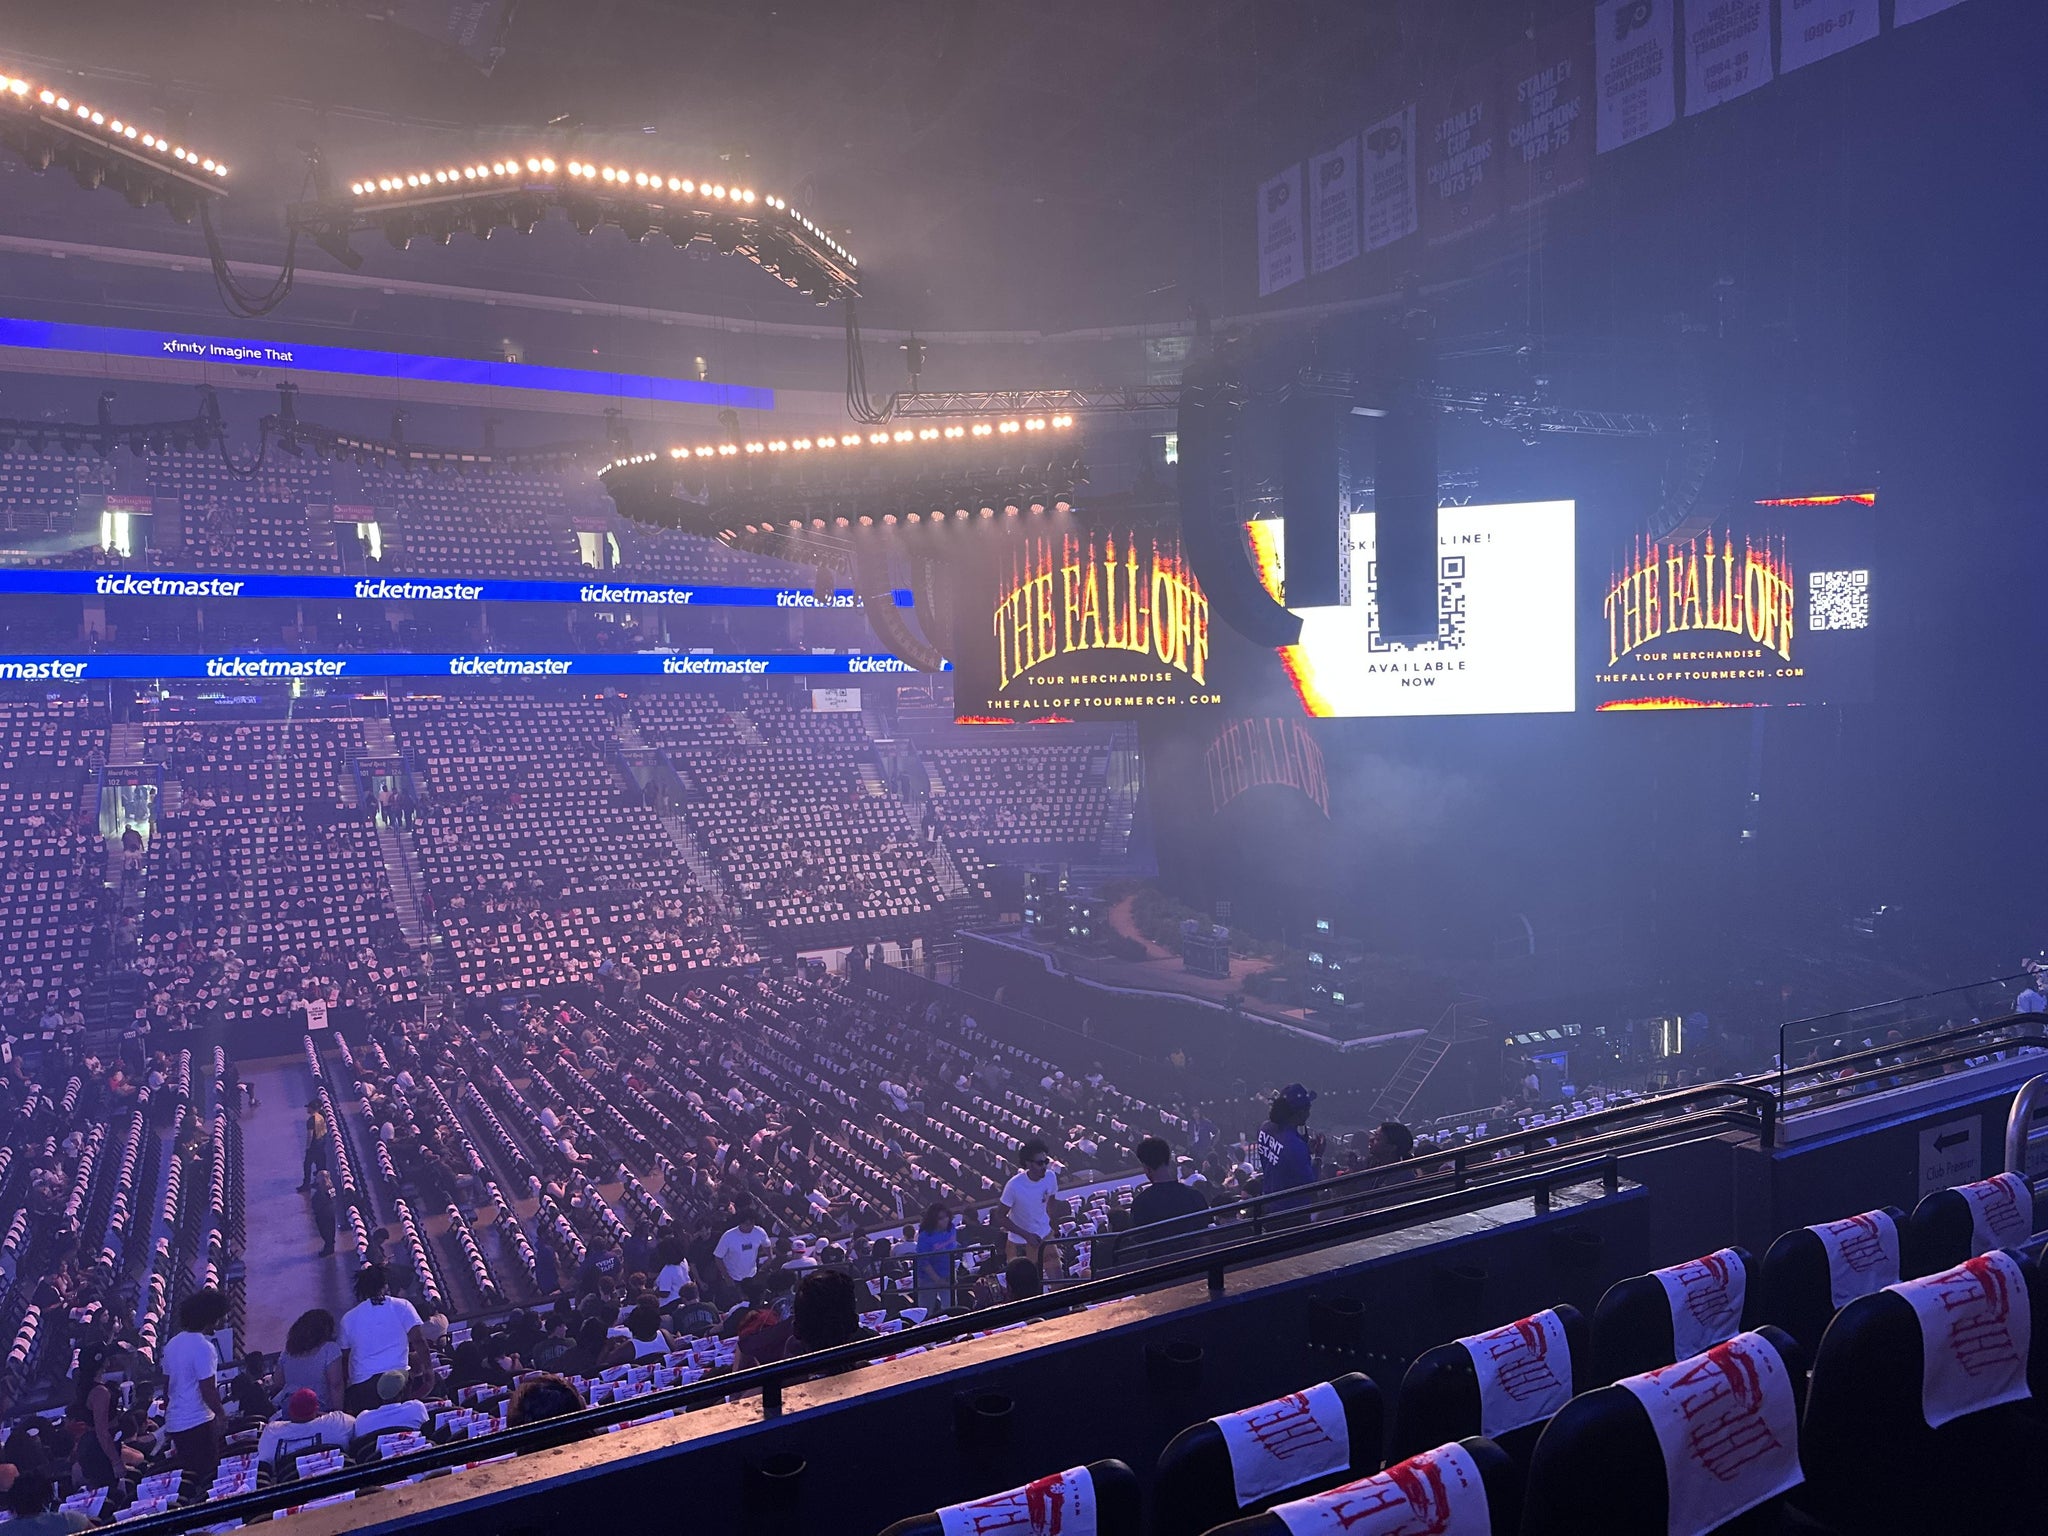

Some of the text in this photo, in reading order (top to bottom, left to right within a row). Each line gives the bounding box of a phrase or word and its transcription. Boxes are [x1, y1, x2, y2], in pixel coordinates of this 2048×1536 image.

[1804, 9, 1855, 43] 1996-97
[1517, 59, 1572, 102] STANLEY
[1531, 88, 1558, 116] CUP
[1434, 102, 1483, 143] STANLEY
[1508, 96, 1581, 147] CHAMPIONS
[1447, 130, 1471, 156] CUP
[1522, 124, 1570, 163] 1974-75
[1439, 165, 1483, 200] 1973-74
[163, 340, 293, 362] xfinity Imagine That
[1350, 533, 1491, 550] SKI LINE!
[96, 575, 244, 596] ticketmaster
[354, 579, 483, 600] ticketmaster
[580, 585, 693, 604] ticketmaster
[993, 560, 1209, 692] THE FALL-OFF
[1604, 554, 1794, 667] THE FALL-OFF
[0, 659, 87, 679] master
[206, 657, 346, 677] ticketmaster
[449, 657, 572, 676] ticketmaster
[663, 657, 769, 674] ticketmaster
[1368, 660, 1467, 674] AVAILABLE
[1635, 649, 1762, 661] TOUR MERCHANDISE
[1028, 672, 1173, 686] TOUR MERCHANDISE
[1401, 677, 1436, 688] NOW
[1203, 720, 1248, 816] THE
[1258, 1130, 1284, 1155] EVENT
[1926, 1164, 1945, 1180] Club
[1948, 1314, 2018, 1377] THE
[1495, 1357, 1562, 1402] THE
[1245, 1409, 1333, 1460] THE
[1688, 1403, 1781, 1482] THE
